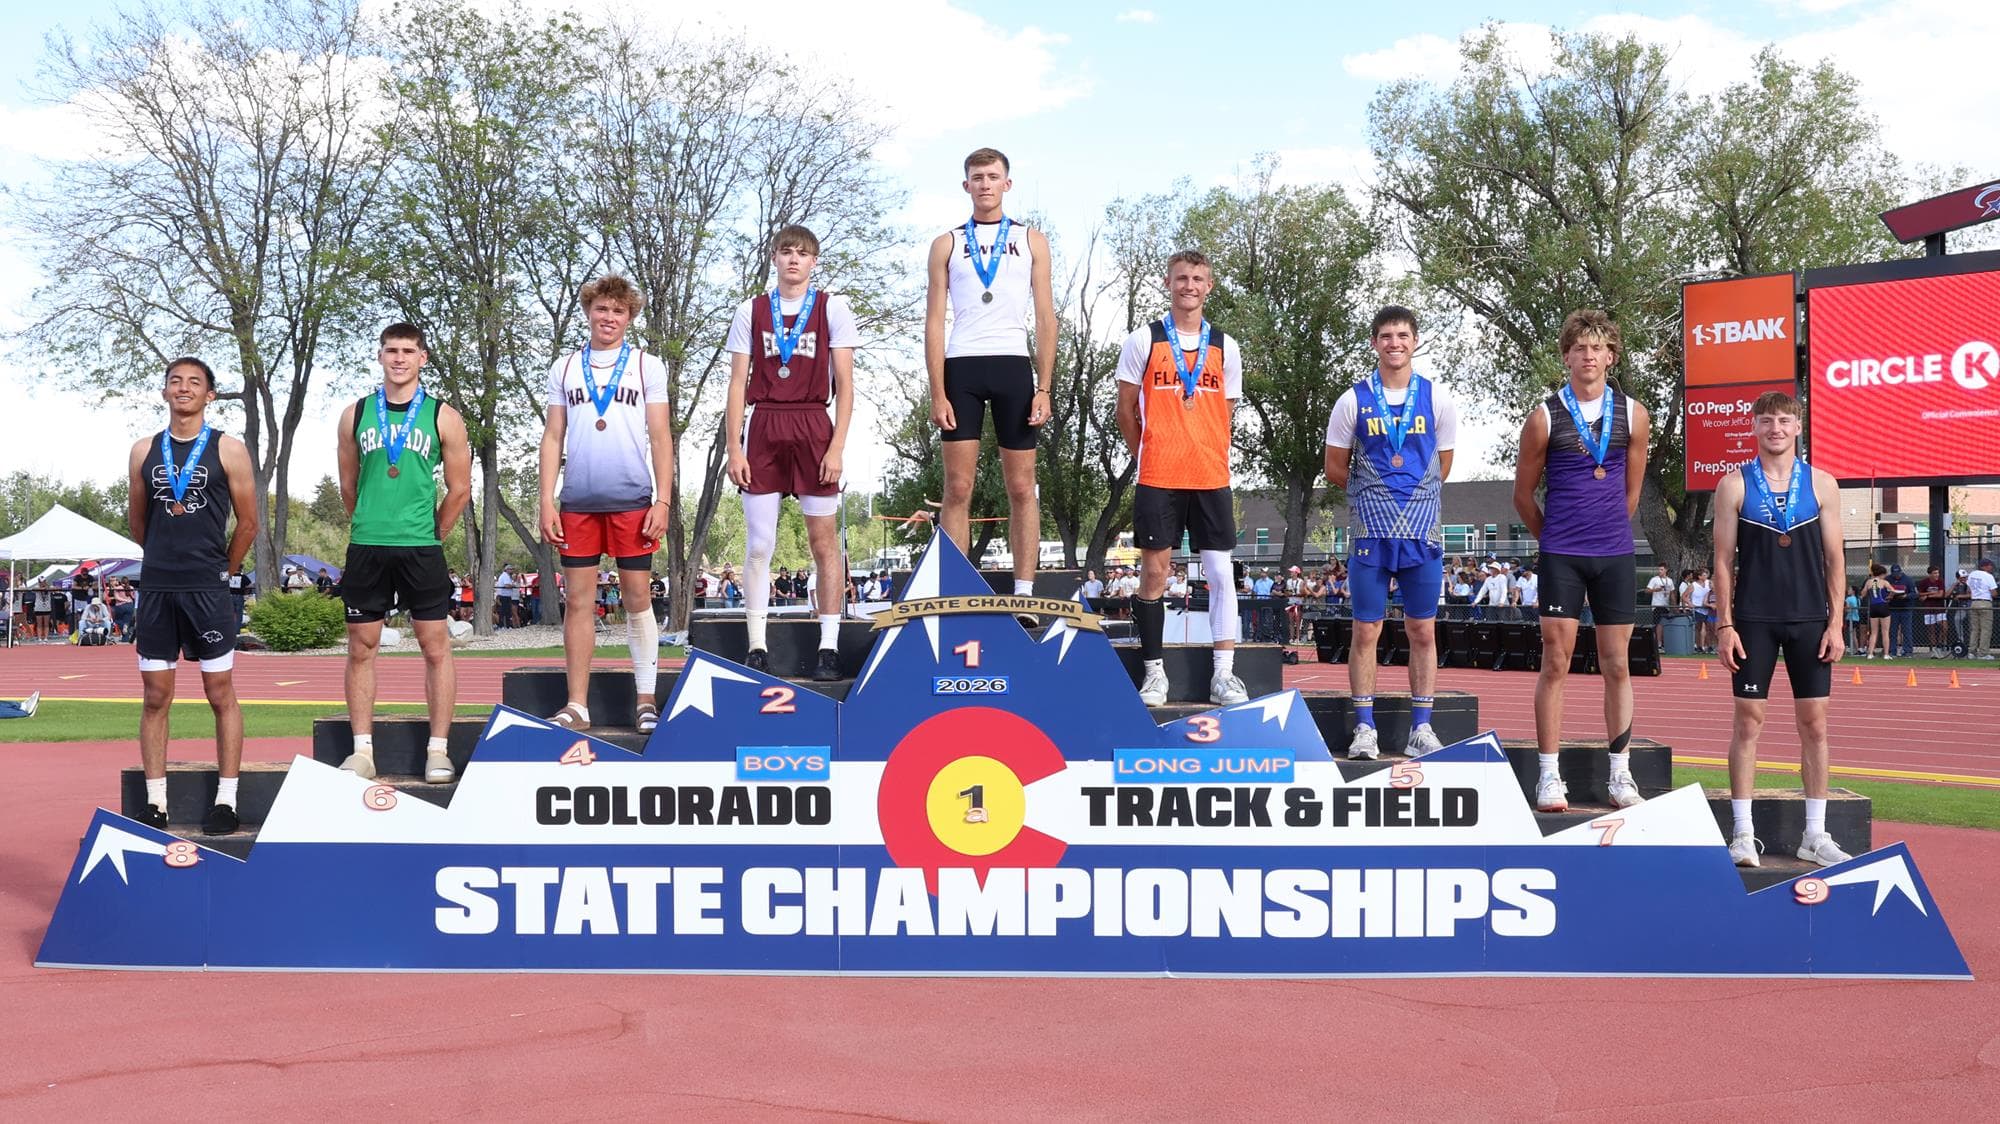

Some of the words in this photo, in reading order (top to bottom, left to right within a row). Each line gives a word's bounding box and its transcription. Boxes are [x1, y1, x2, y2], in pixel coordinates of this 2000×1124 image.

[1154, 371, 1219, 388] FLAER
[1826, 354, 1943, 388] CIRCLE
[567, 385, 639, 408] HAUN
[1688, 402, 1705, 415] CO
[1707, 401, 1735, 416] Prep
[1703, 418, 1713, 428] We
[898, 599, 961, 614] STATE
[967, 597, 1076, 614] CHAMPION
[953, 640, 982, 668] 1
[935, 679, 1007, 693] 2026
[760, 686, 796, 714] 2
[1185, 716, 1223, 743] 3
[559, 739, 597, 766] 4
[744, 756, 825, 772] BOYS
[1118, 758, 1200, 774] LONG
[1210, 757, 1291, 774] JUMP
[1389, 761, 1425, 790] 5
[363, 784, 398, 811] 6
[536, 786, 832, 826] COLORADO
[1081, 787, 1272, 828] TRACK
[1284, 788, 1324, 828] &
[1333, 787, 1479, 828] FIELD
[1591, 818, 1624, 847] 7
[163, 841, 199, 869] 8
[435, 866, 724, 935] STATE
[741, 866, 1557, 938] CHAMPIONSHIPS
[1792, 877, 1830, 905] 9
